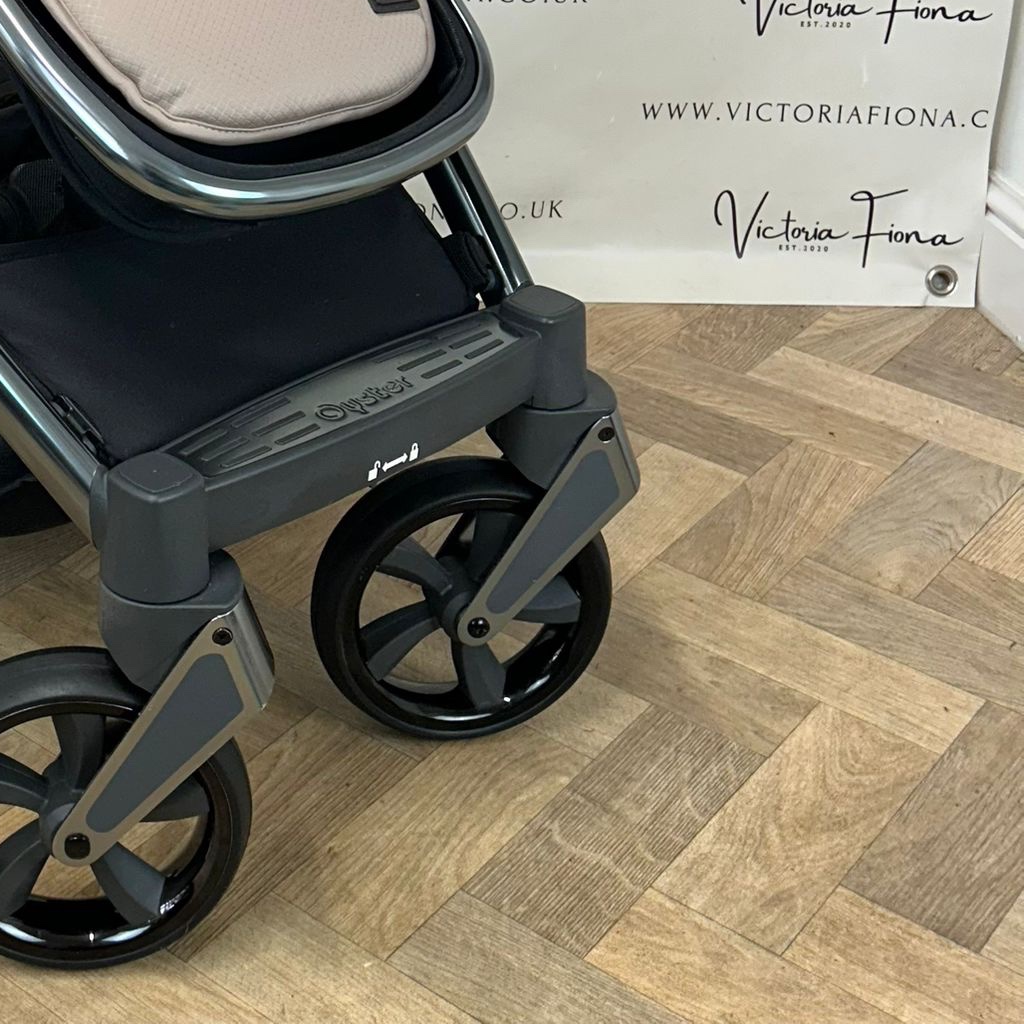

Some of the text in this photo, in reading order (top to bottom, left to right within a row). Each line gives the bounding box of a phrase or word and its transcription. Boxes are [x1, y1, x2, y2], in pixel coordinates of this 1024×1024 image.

[800, 20, 852, 29] EST.2020
[642, 102, 990, 129] WWW.VICTORIAFIONA.C
[714, 189, 964, 268] Victoria Fiona
[779, 244, 829, 252] EST.2020
[314, 375, 414, 422] Oyster
